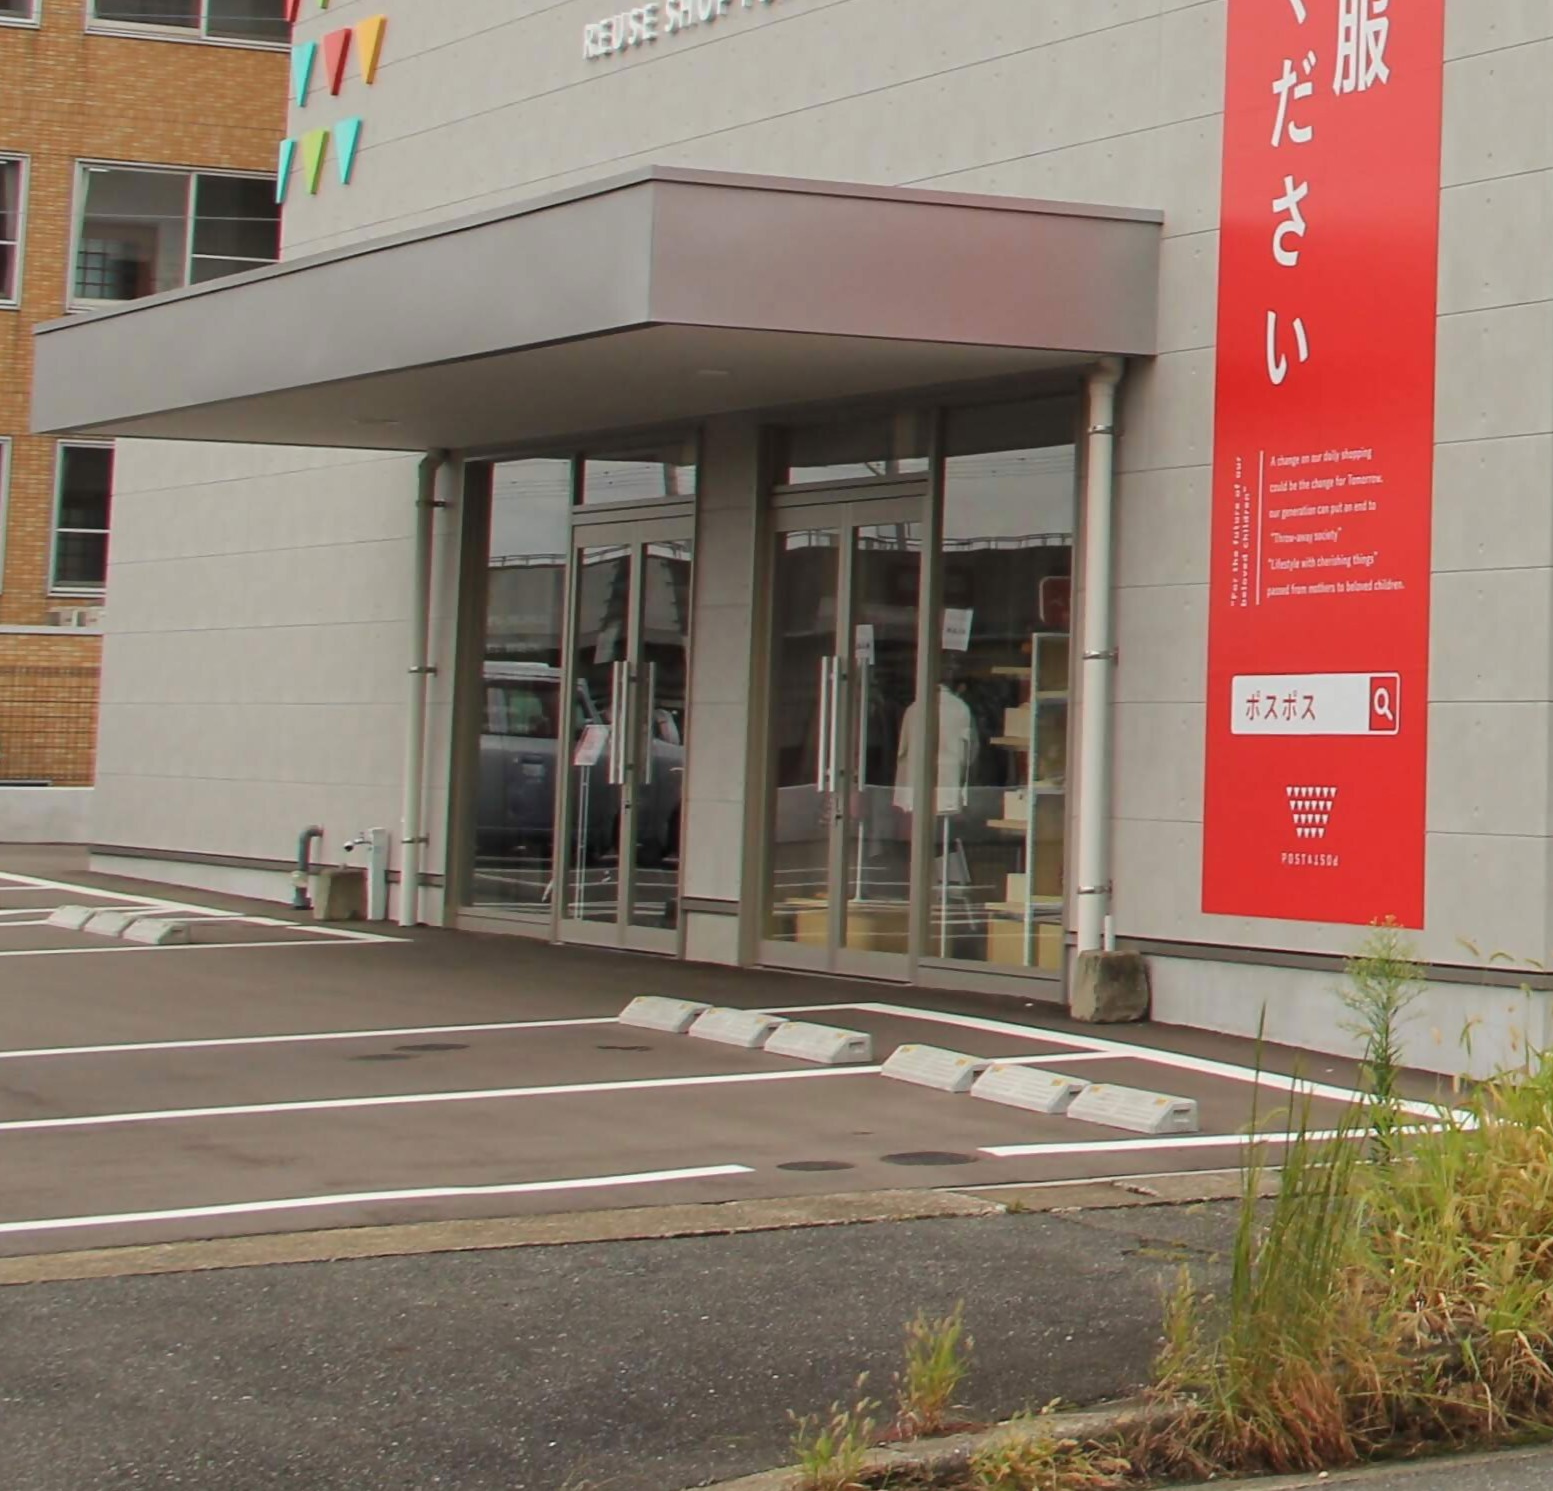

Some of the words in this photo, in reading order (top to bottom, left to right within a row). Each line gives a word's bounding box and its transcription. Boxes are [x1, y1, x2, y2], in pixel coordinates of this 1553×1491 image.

[582, 3, 660, 60] REUSE
[1245, 689, 1316, 721] ポスポス
